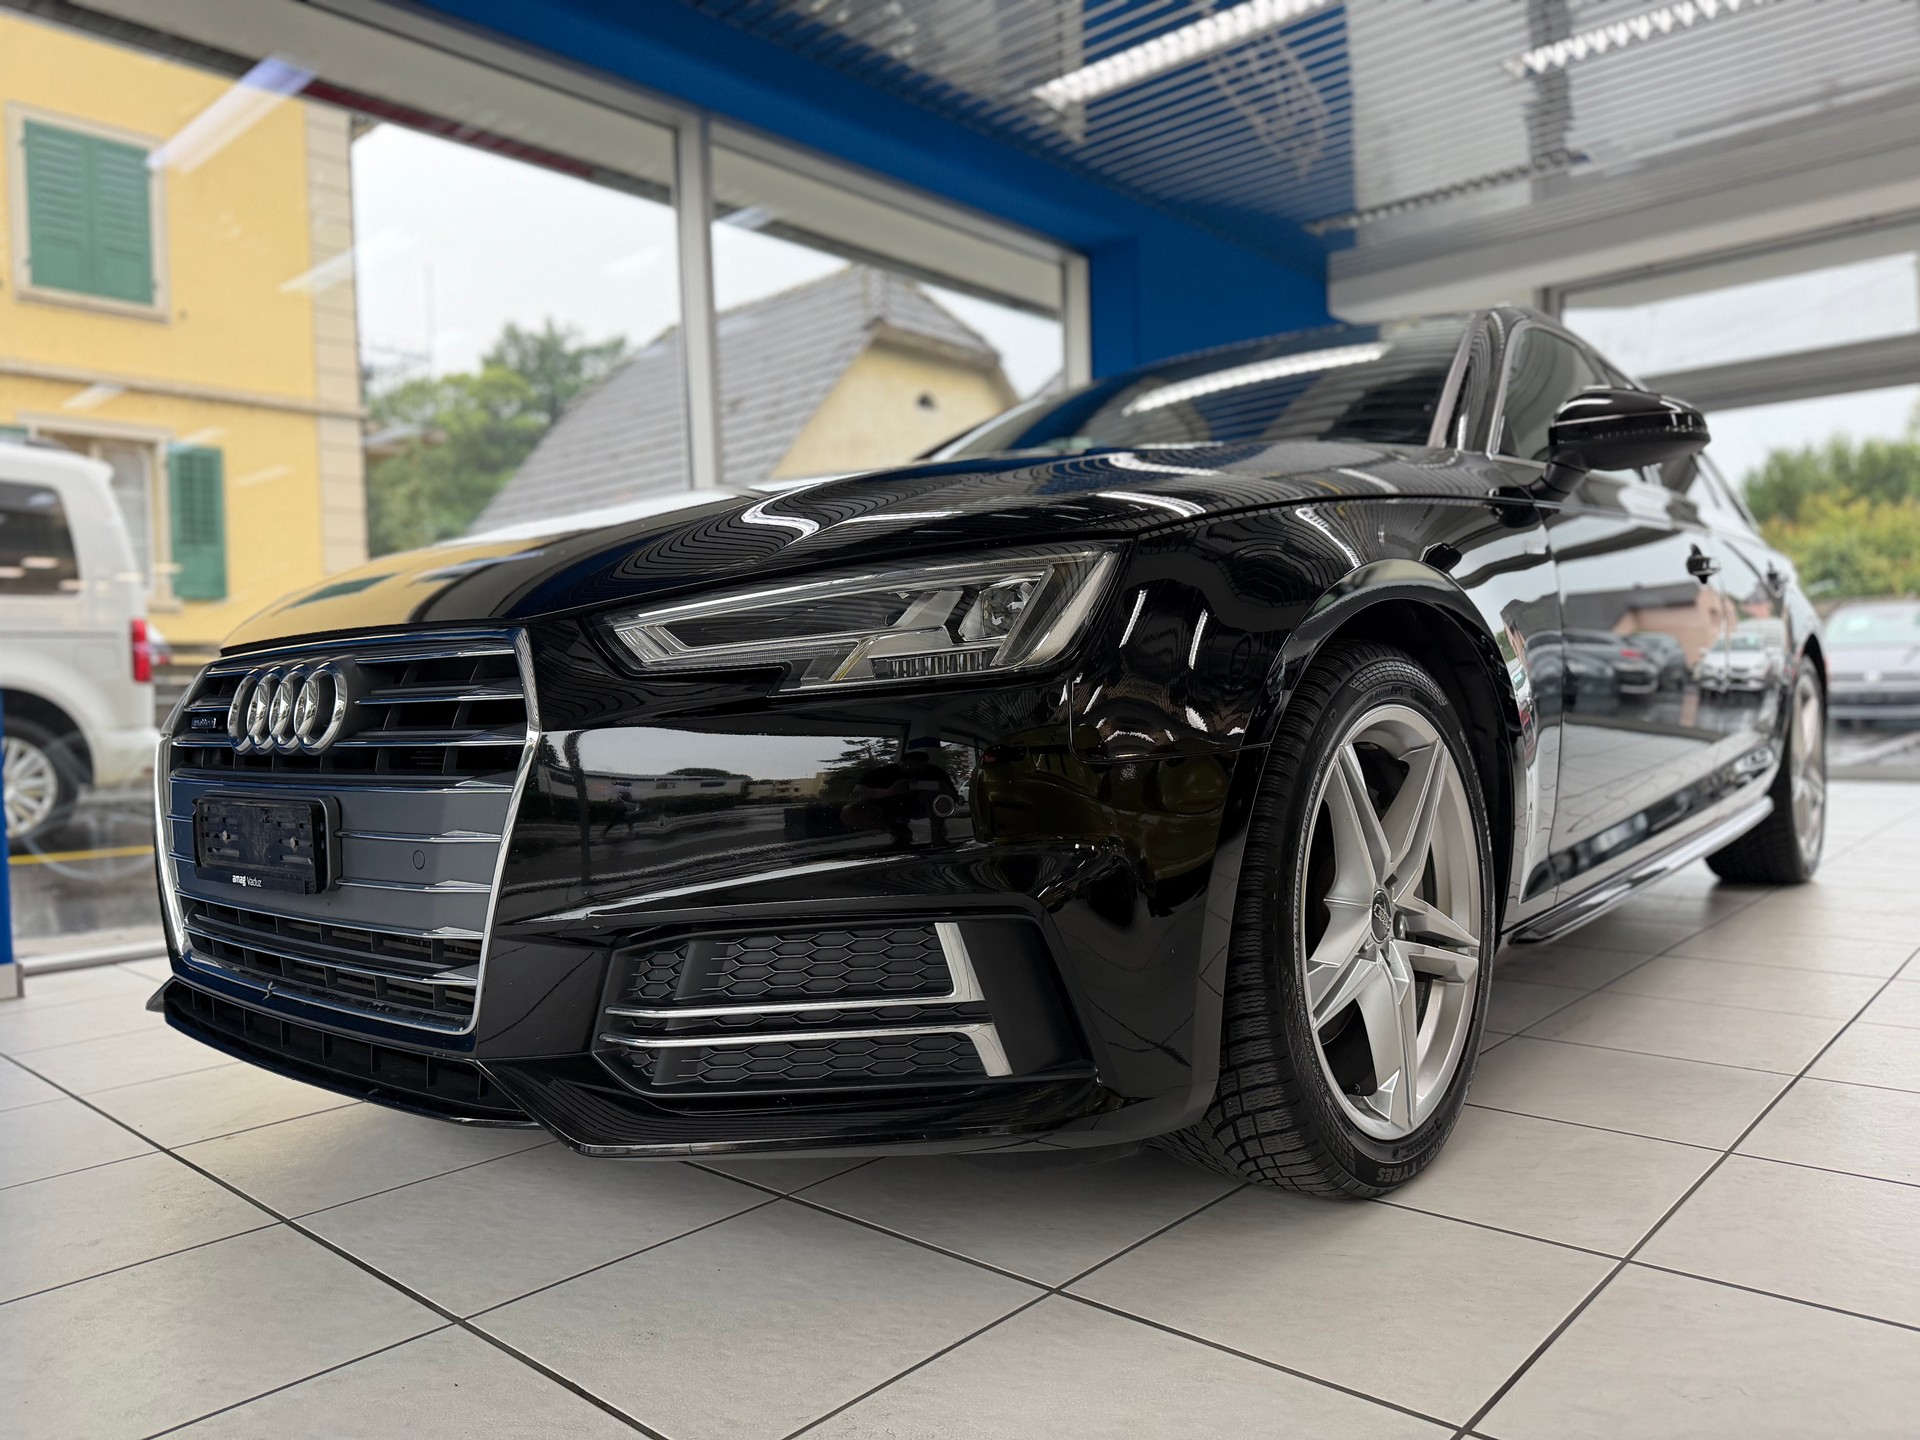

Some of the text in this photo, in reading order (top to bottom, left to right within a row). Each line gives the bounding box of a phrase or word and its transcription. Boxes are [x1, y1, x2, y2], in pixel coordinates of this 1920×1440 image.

[232, 875, 262, 888] amag Vaduz
[1376, 1162, 1418, 1183] TYRES
